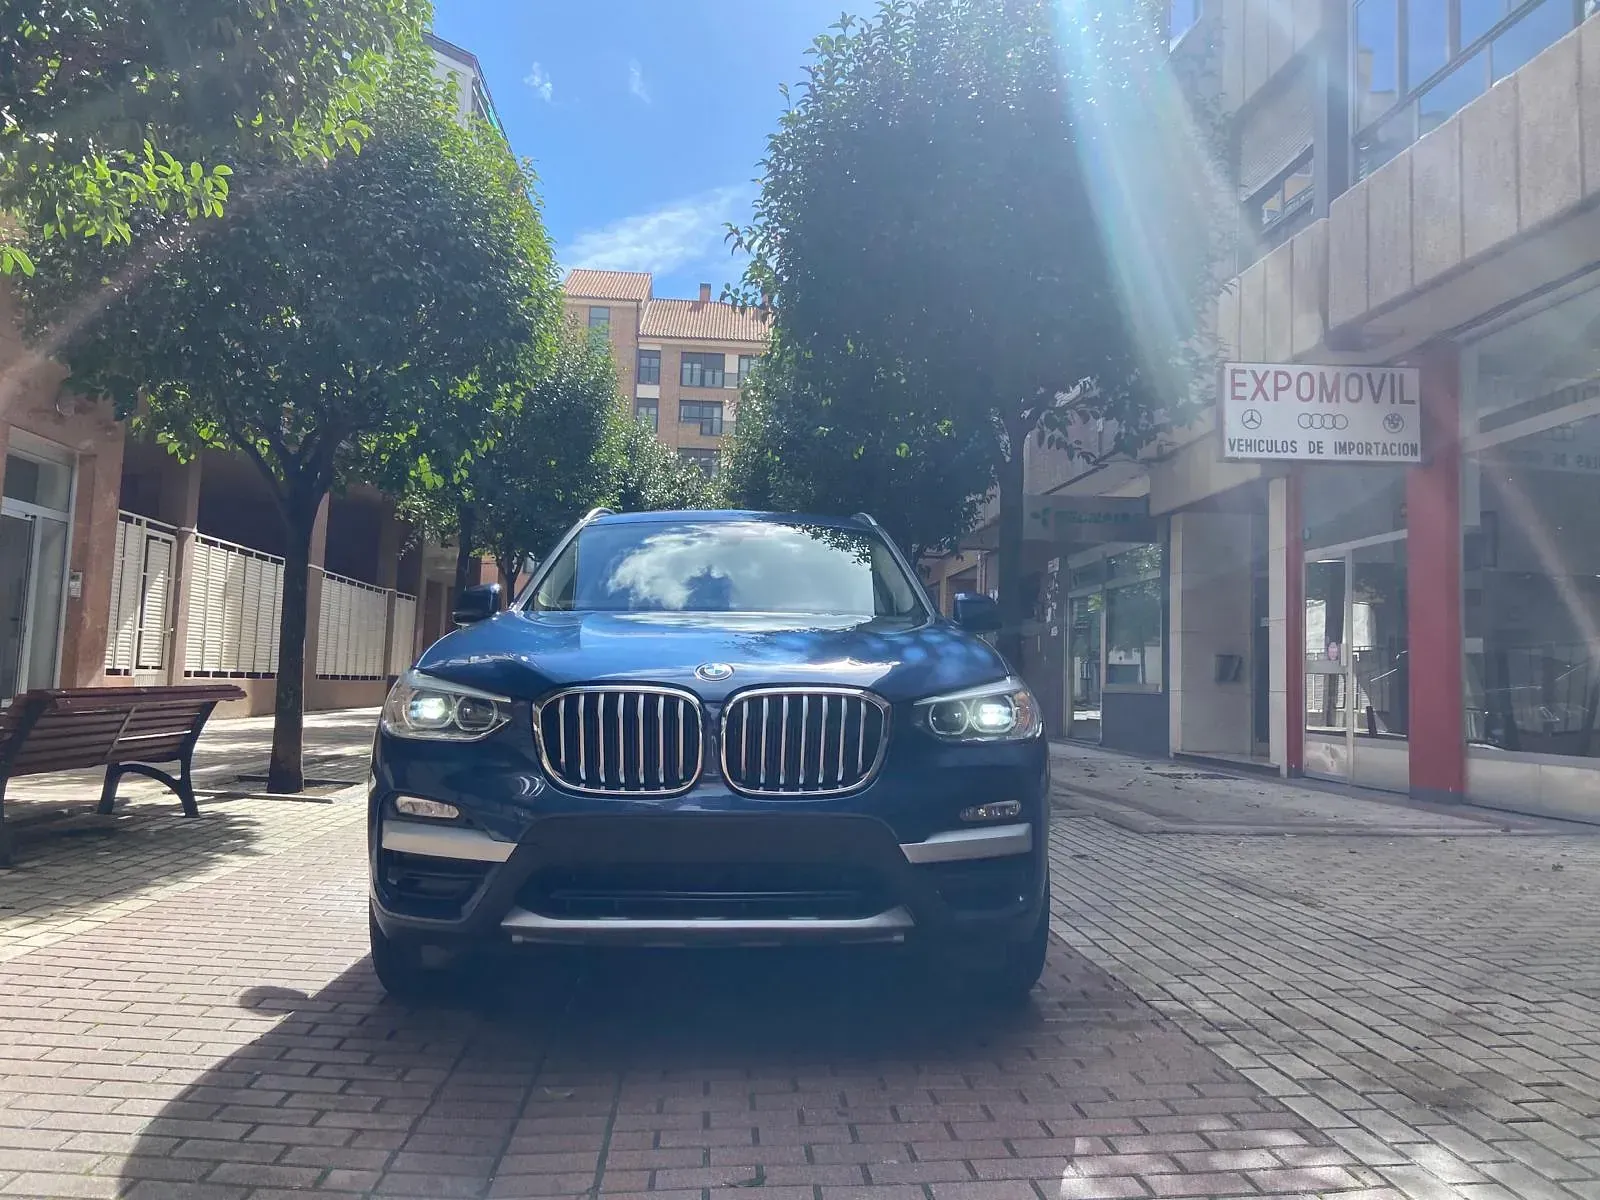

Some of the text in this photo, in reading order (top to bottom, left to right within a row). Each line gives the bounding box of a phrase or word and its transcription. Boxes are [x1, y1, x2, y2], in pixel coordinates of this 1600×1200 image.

[1230, 369, 1416, 405] EXPOMOVIL
[1228, 438, 1418, 457] VEHICULOS DE IMPORTACION
